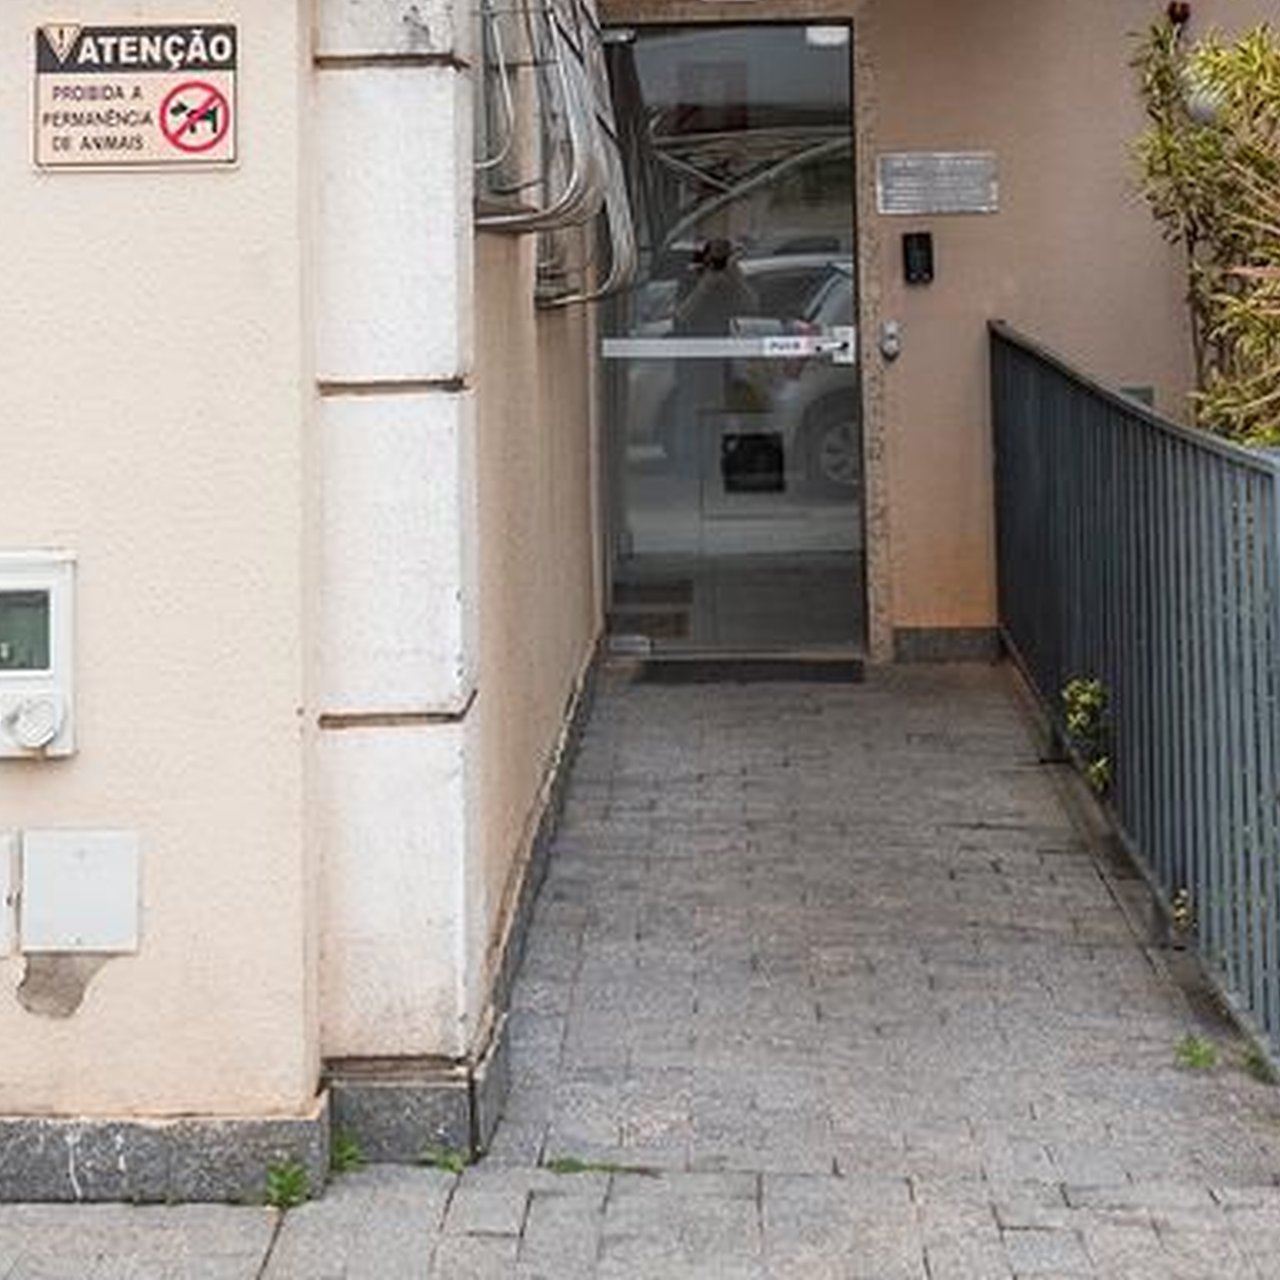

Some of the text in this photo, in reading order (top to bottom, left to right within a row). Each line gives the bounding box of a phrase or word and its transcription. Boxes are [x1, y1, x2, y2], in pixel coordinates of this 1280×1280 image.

[78, 28, 233, 69] ATENÇÃO
[52, 85, 143, 102] PROIBIDA A
[42, 109, 153, 128] PERMANÊNCIA
[52, 135, 144, 151] DE ANIMAIS
